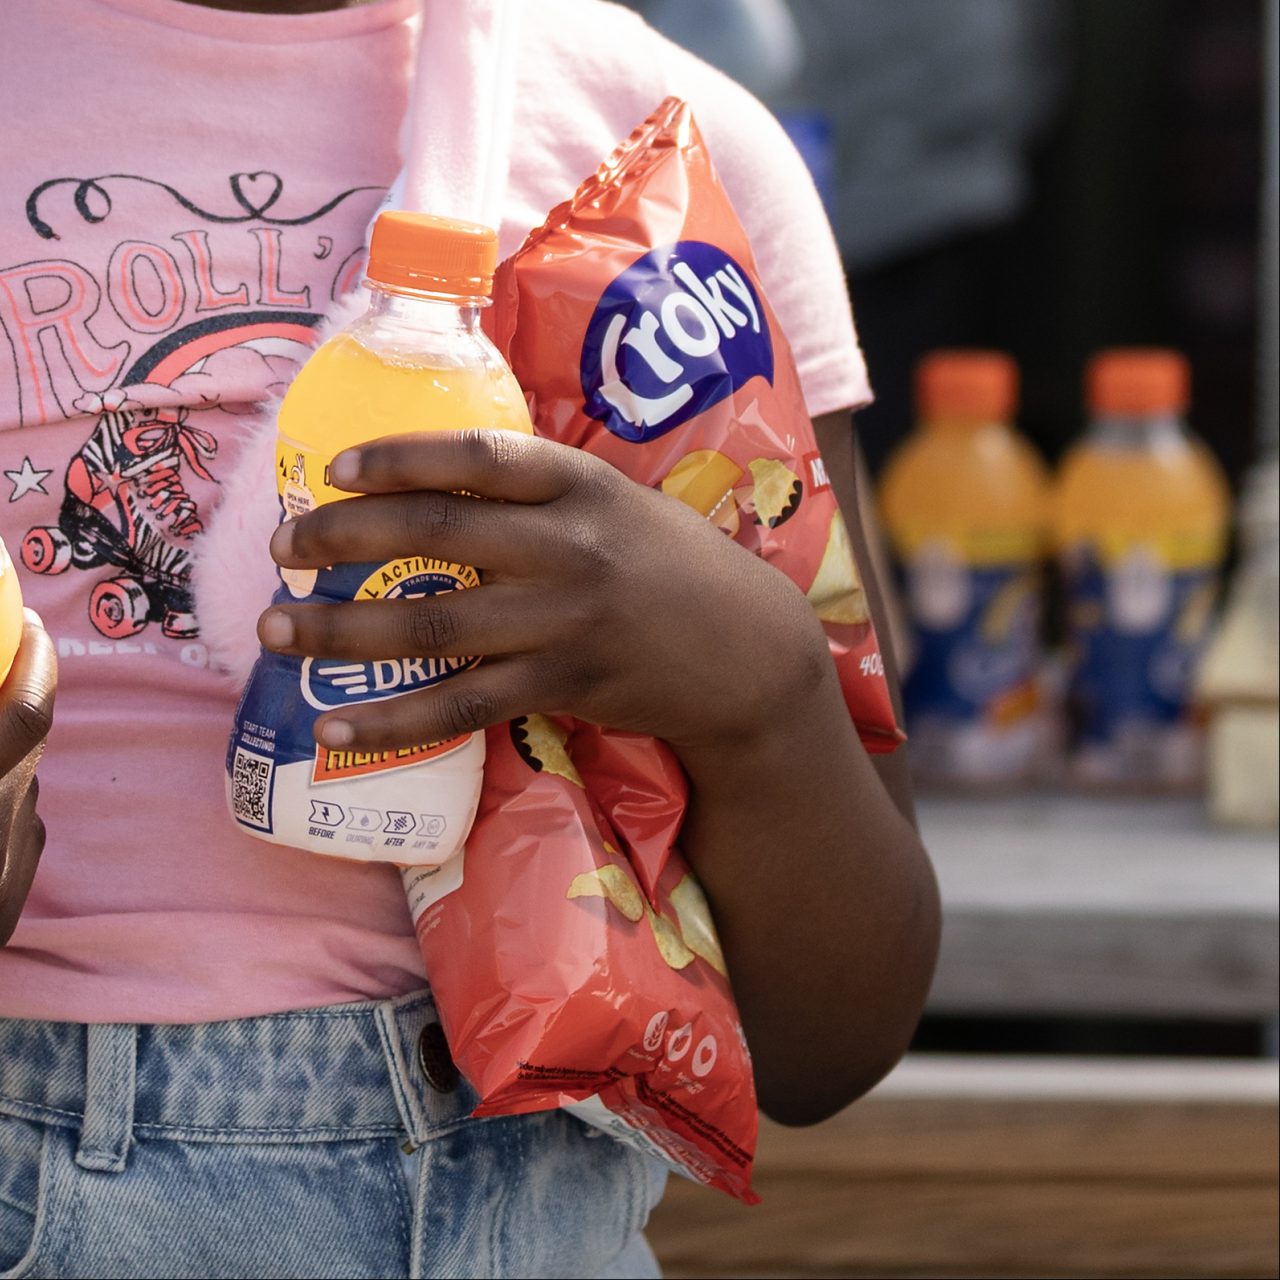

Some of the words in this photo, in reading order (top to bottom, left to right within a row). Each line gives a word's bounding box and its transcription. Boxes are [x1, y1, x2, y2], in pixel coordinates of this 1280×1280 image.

[597, 262, 761, 427] Croky
[380, 558, 452, 587] ACTIVITY
[405, 575, 430, 588] TRADE
[432, 574, 453, 585] MARK
[259, 725, 276, 740] TEAM
[308, 826, 336, 839] BEFORE
[384, 837, 405, 847] AFTER
